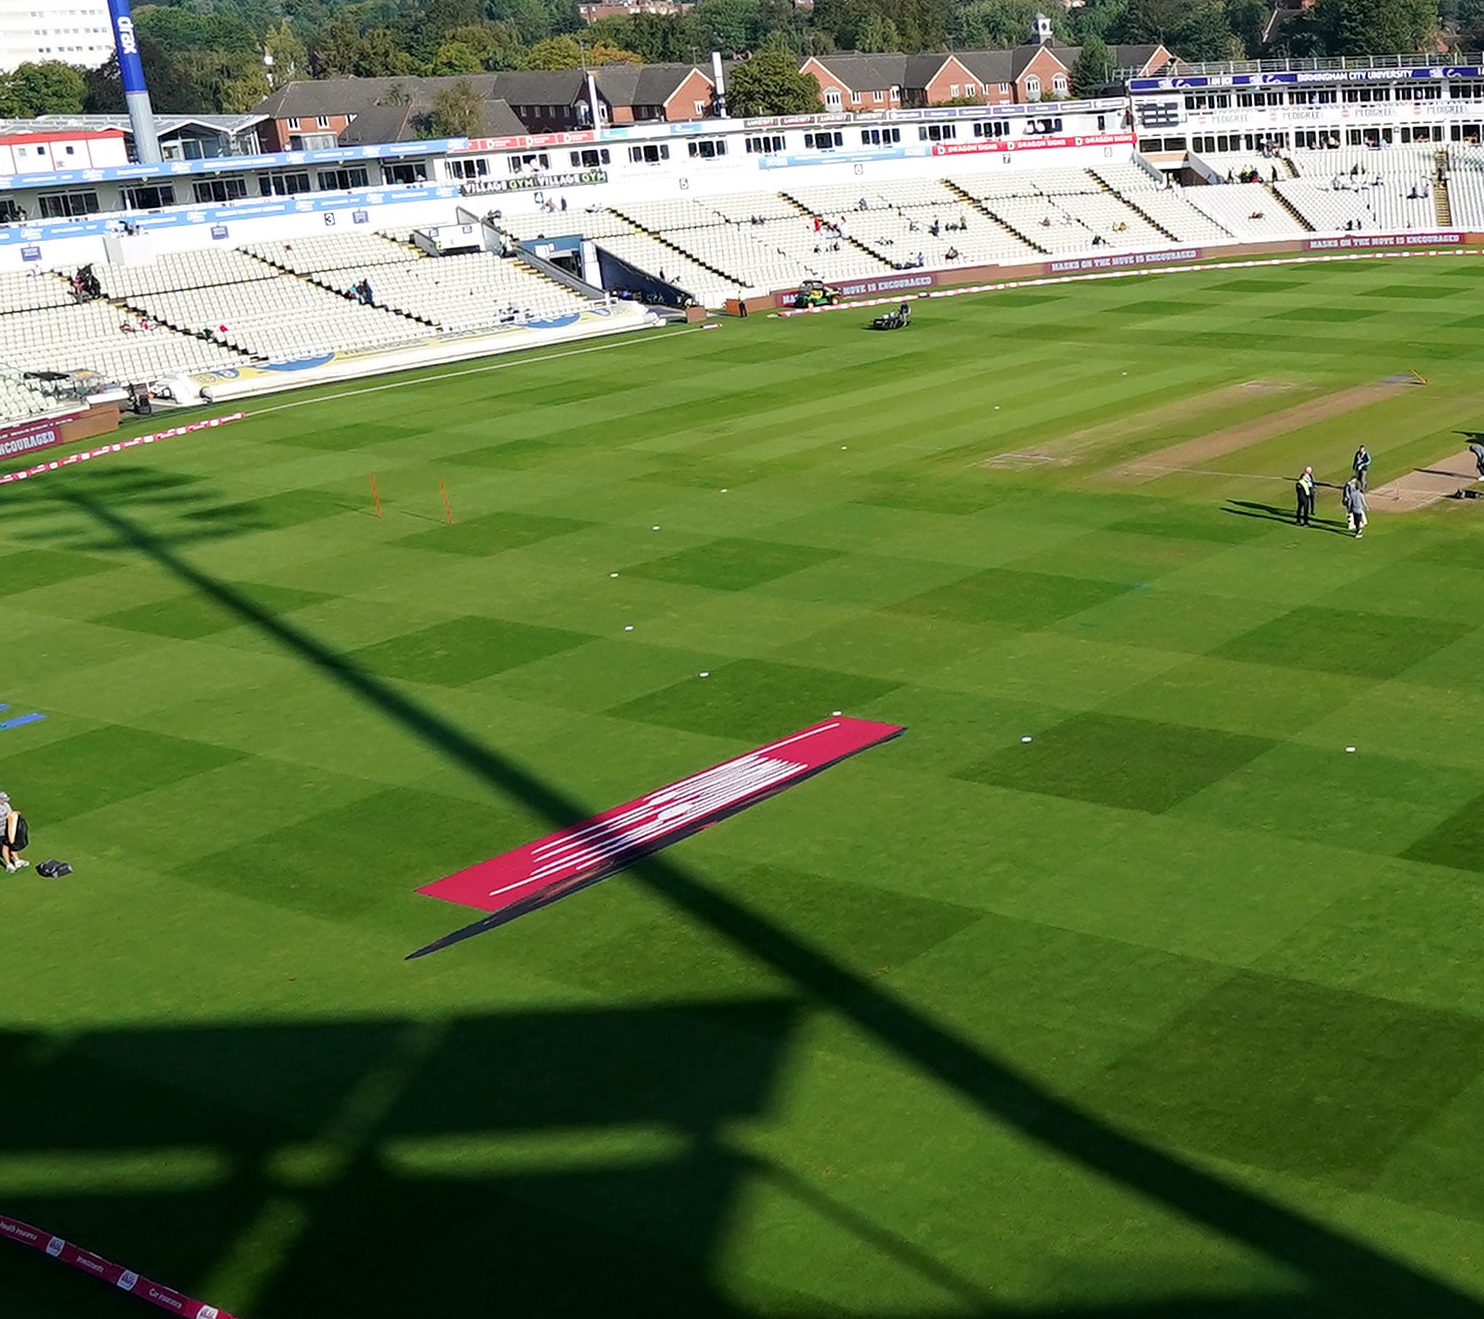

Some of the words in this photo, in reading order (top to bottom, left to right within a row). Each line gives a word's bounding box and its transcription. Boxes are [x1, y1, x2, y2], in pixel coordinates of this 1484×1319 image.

[117, 16, 137, 54] drax
[1018, 141, 1046, 149] DRAGON
[1046, 139, 1066, 148] SIGNS
[1085, 137, 1112, 145] DRAGON
[1113, 135, 1133, 143] SIGNS
[948, 144, 976, 153] DRAGON
[978, 143, 998, 151] SIGNS
[538, 173, 580, 187] VILLAGE
[581, 171, 608, 183] GYM
[466, 181, 508, 194] VILLAGE
[509, 177, 534, 189] GYM
[324, 213, 335, 225] 3
